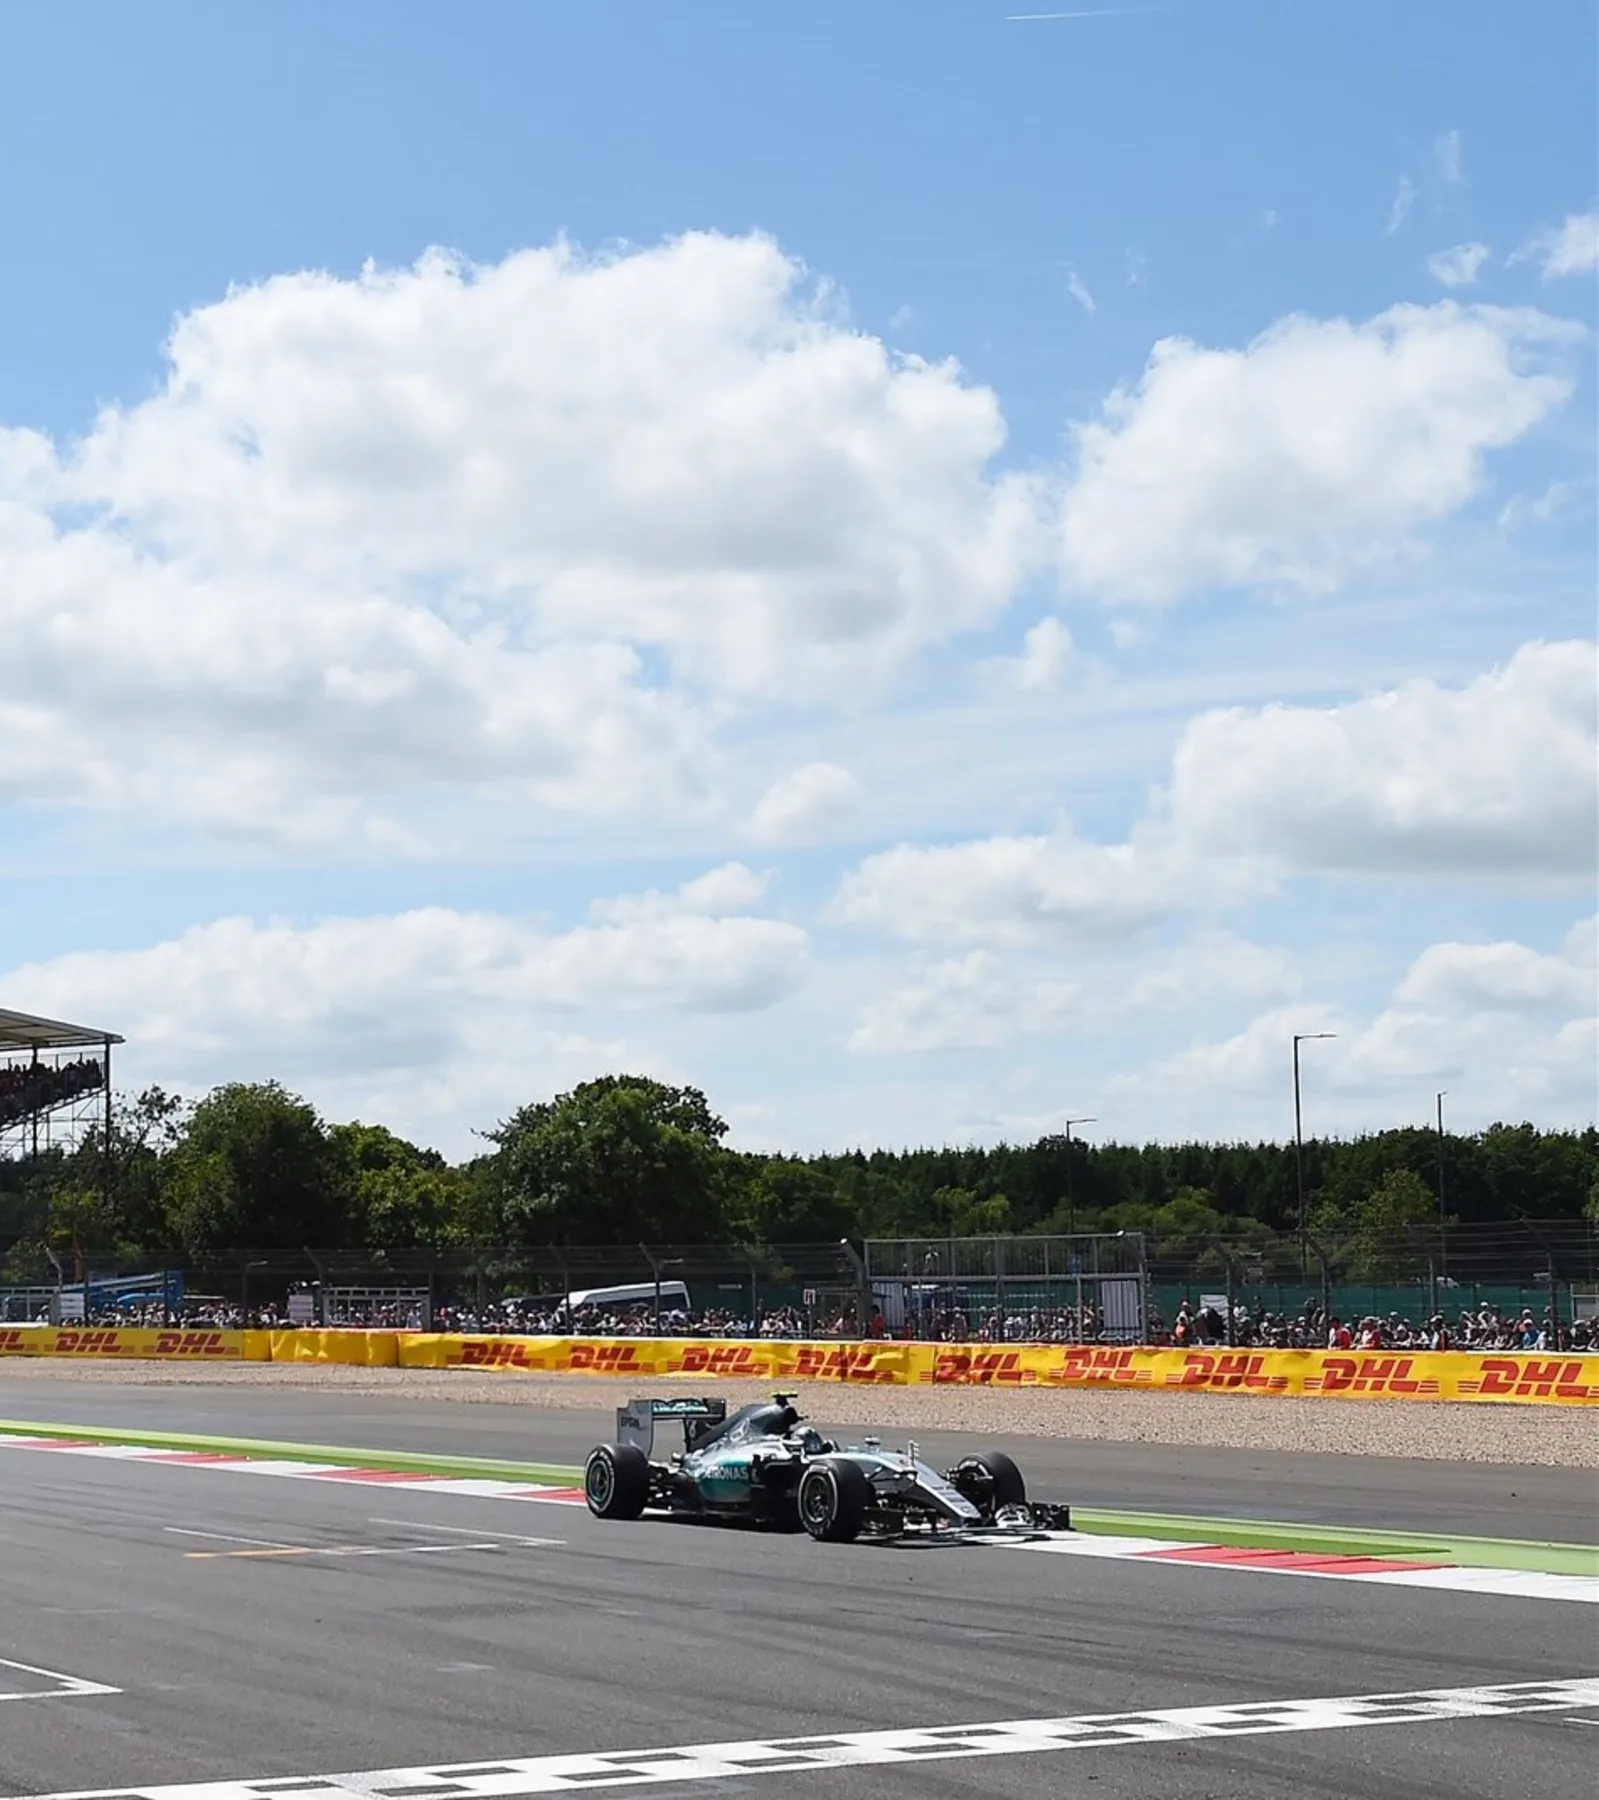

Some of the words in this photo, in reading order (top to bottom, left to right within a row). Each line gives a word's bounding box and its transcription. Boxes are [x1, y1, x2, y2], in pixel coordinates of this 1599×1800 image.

[55, 1332, 121, 1353] DHL
[155, 1333, 224, 1354] DHL
[460, 1342, 530, 1367] DHL
[570, 1346, 639, 1371] DHL
[681, 1347, 754, 1373] DHL
[795, 1349, 876, 1379] DHL
[935, 1353, 1023, 1384] DHL
[1063, 1350, 1136, 1380] DHL
[1181, 1355, 1269, 1387] DHL
[1321, 1358, 1418, 1392] DHL
[1479, 1360, 1589, 1397] DHL
